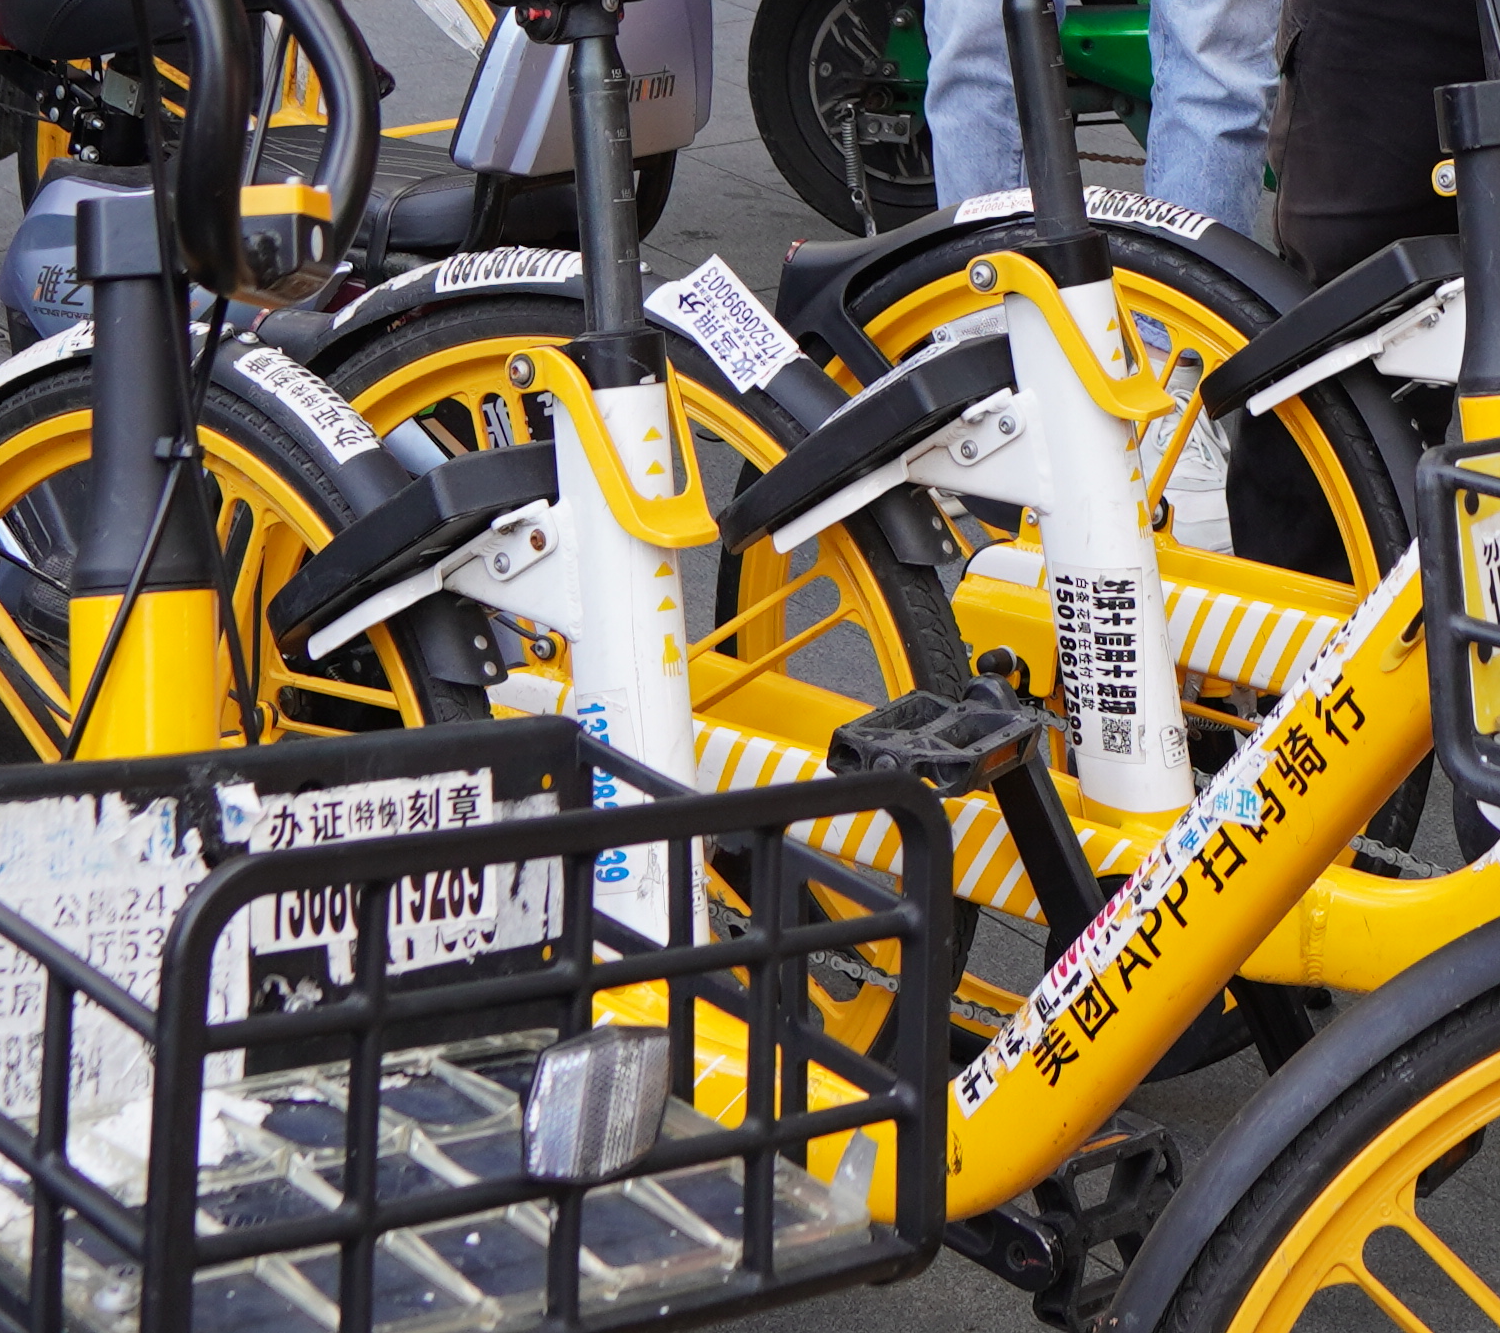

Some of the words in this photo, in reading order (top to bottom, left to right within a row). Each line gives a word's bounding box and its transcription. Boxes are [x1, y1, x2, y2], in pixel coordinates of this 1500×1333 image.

[707, 265, 792, 356] 17520699003
[269, 783, 482, 850] 办证(特快)刻章
